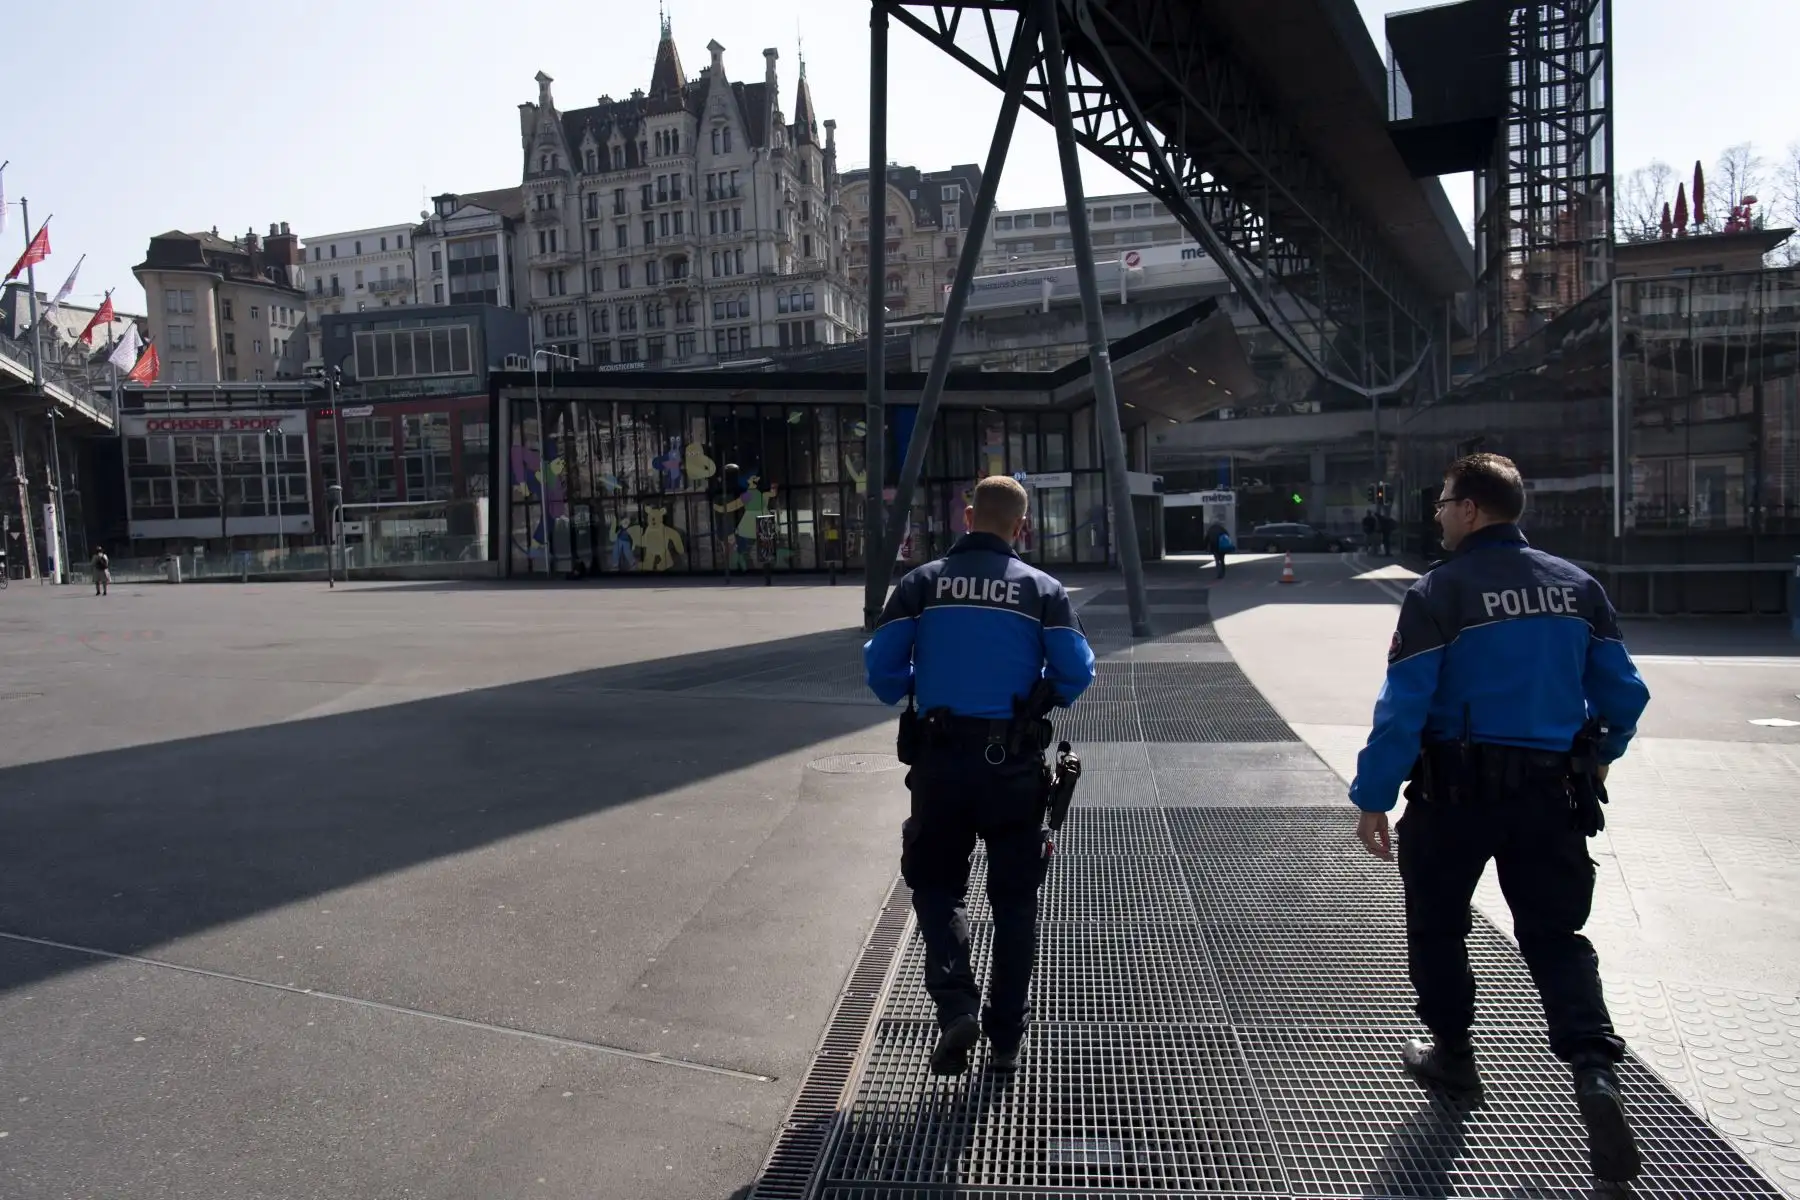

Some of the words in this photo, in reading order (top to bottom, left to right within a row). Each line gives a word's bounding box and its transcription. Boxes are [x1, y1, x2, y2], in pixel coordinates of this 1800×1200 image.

[146, 419, 224, 430] OCHSNER
[230, 418, 281, 430] SPORT
[936, 576, 1021, 604] POLICE
[1482, 586, 1578, 617] POLICE
